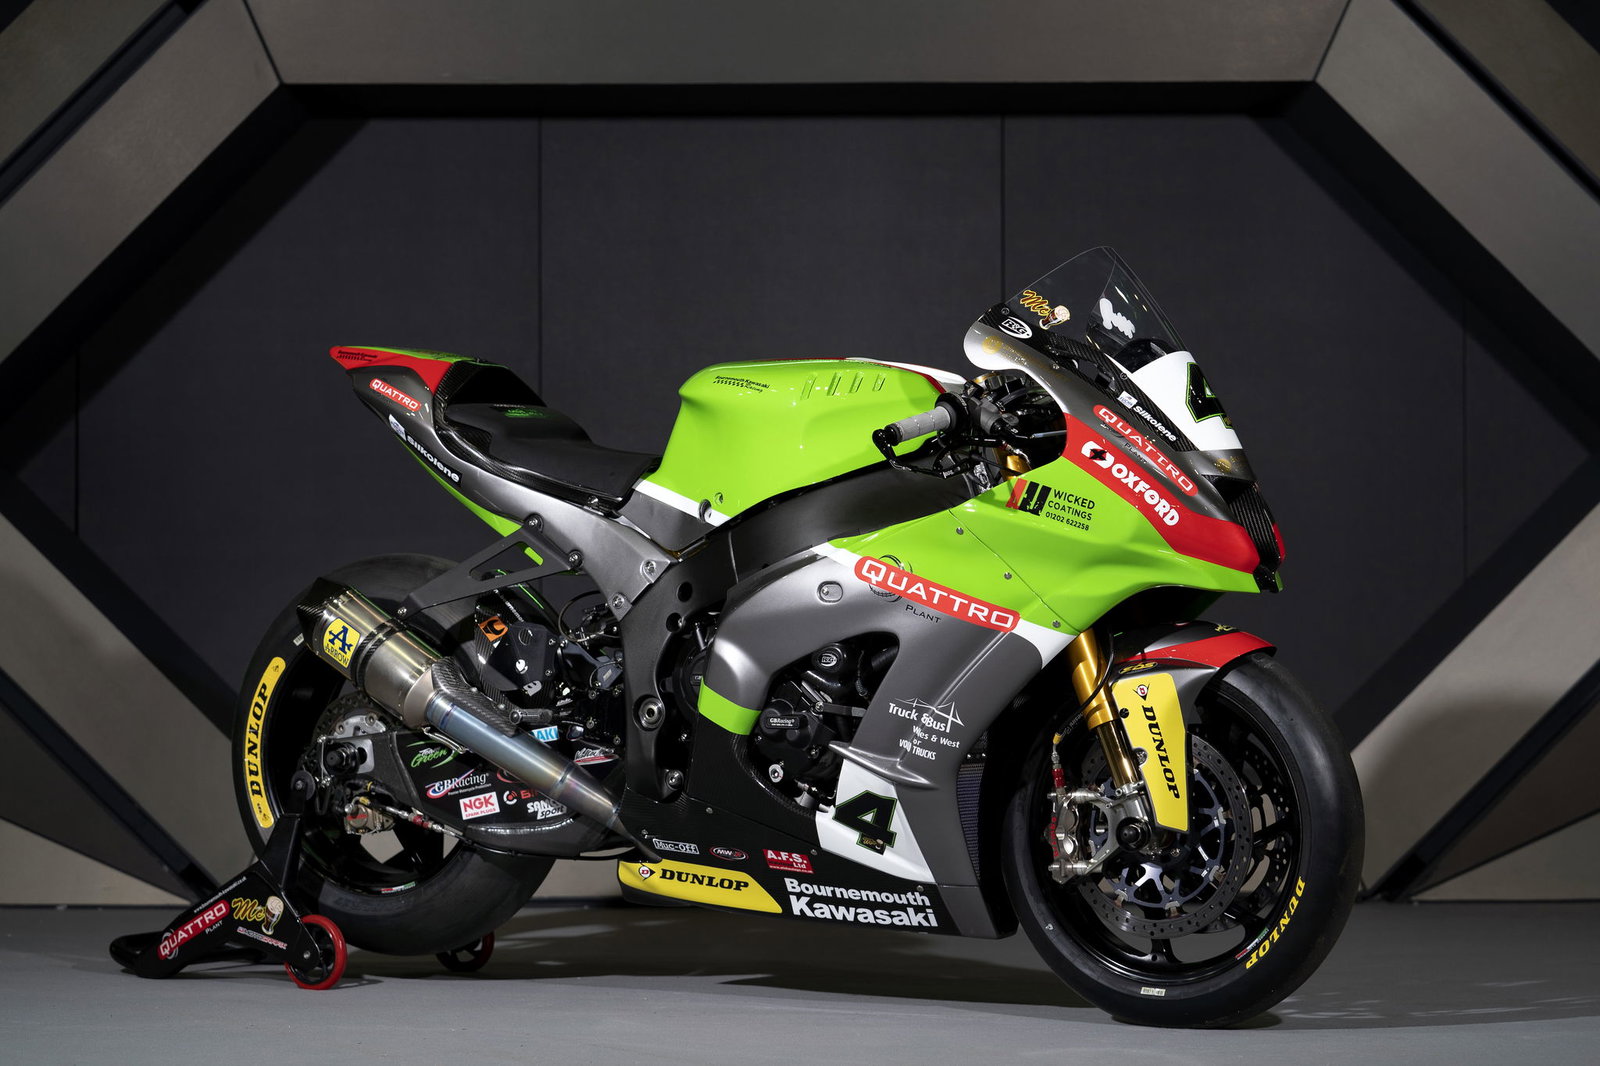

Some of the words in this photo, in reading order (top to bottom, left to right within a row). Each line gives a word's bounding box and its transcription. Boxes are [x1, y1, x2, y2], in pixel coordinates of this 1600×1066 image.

[371, 379, 418, 410] QUATTRO
[1132, 405, 1178, 442] Silkolene
[406, 434, 460, 483] Silkolene
[1098, 407, 1194, 492] QUATTRO
[1124, 442, 1149, 465] PLANT
[1053, 488, 1096, 510] WICKED
[1111, 463, 1180, 526] OXFORD
[1045, 511, 1065, 523] 01202
[1065, 518, 1090, 531] 622258
[1047, 500, 1093, 521] COATINGS
[861, 559, 1014, 629] QUATTRO
[905, 604, 942, 624] PLANT
[323, 642, 350, 667] ARROW
[888, 702, 919, 721] Truck
[925, 715, 947, 732] Bus
[248, 682, 269, 799] DUNLOP
[912, 738, 922, 746] or
[930, 735, 938, 743] &
[939, 736, 961, 749] West
[1141, 704, 1181, 800] DUNLOP
[410, 749, 448, 768] Green
[912, 745, 937, 761] TRUCKS
[462, 794, 495, 813] NGK
[480, 807, 496, 815] PLUGS
[540, 805, 565, 819] sport
[832, 789, 898, 856] 4
[655, 840, 697, 853] Muc-Off
[767, 849, 808, 864] A.F.S.
[659, 868, 749, 891] DUNLOP
[784, 877, 931, 907] Bournemouth
[789, 894, 938, 928] Kawasaki
[1245, 876, 1305, 969] DUNLOP
[159, 902, 227, 957] QUATTRO
[205, 920, 223, 935] PLANT
